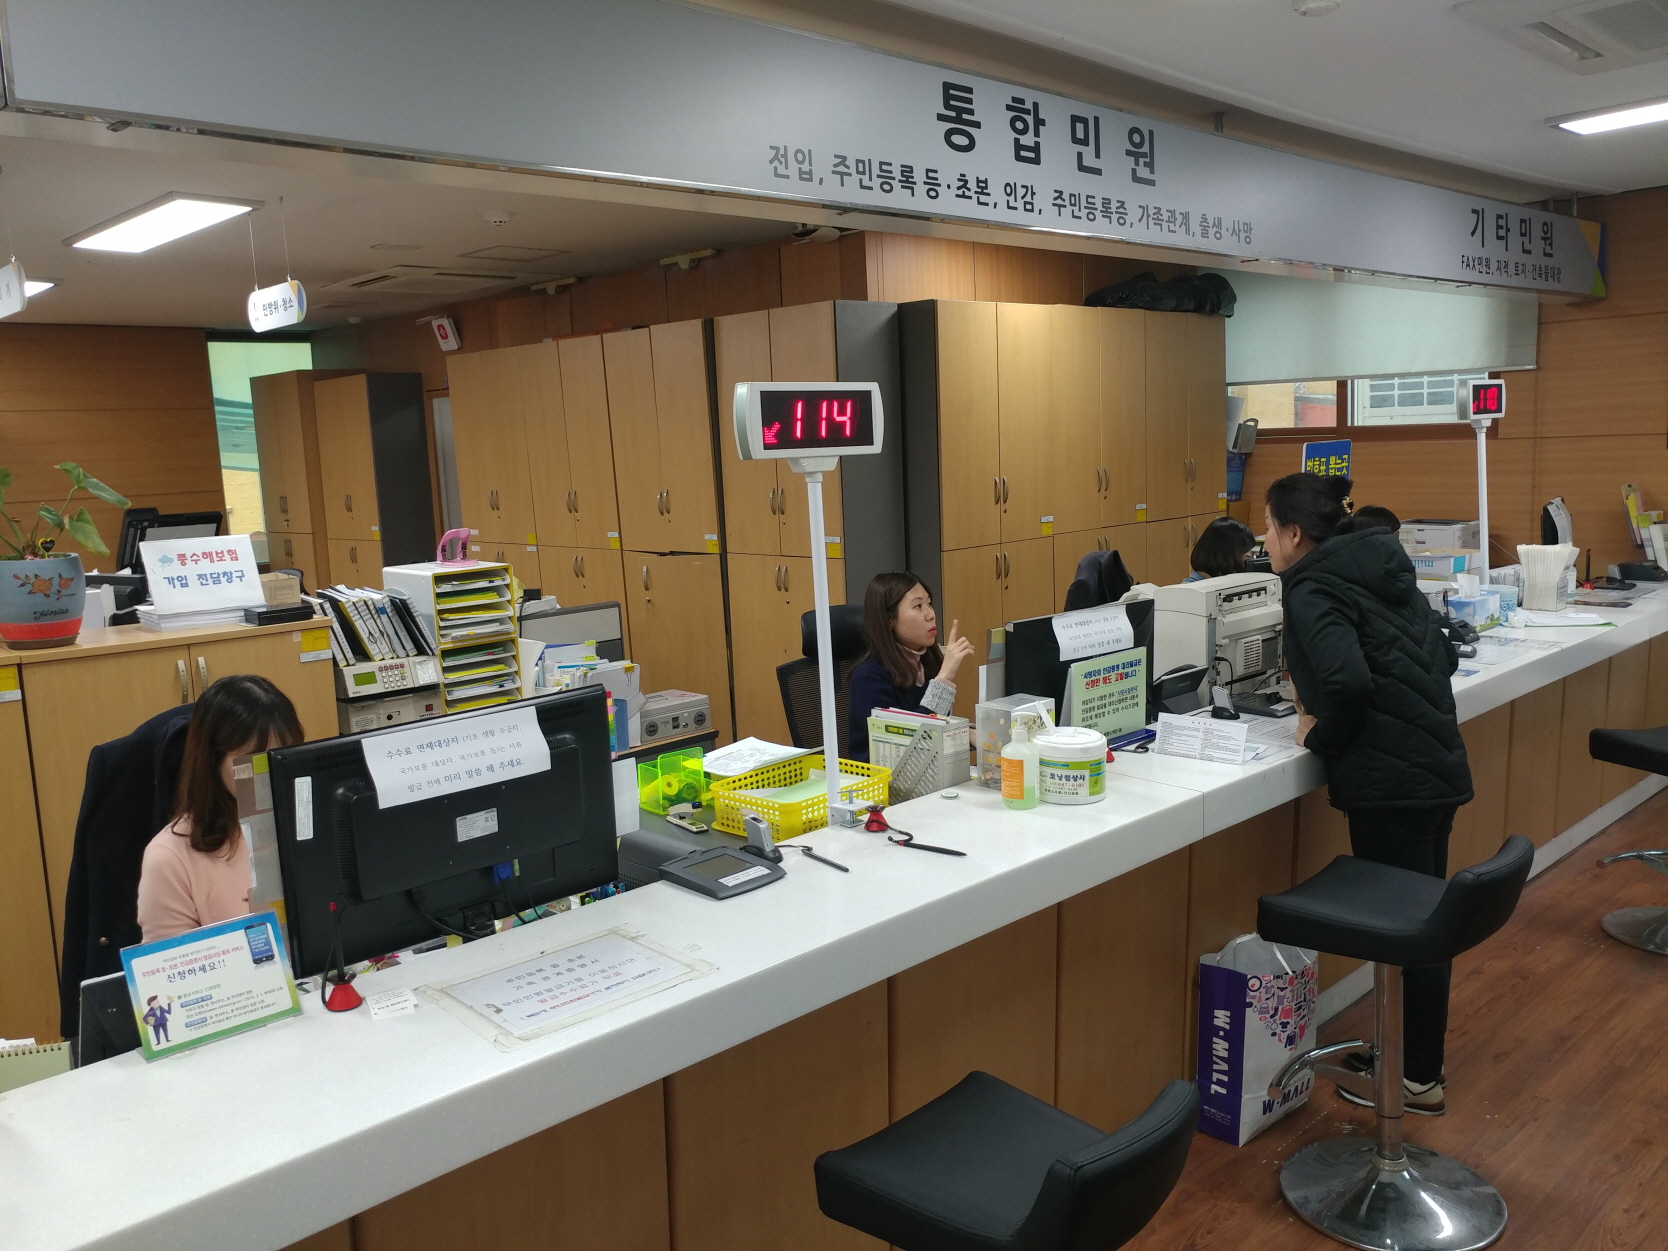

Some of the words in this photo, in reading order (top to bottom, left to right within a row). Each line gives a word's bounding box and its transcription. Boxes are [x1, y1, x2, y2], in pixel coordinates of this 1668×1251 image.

[1470, 208, 1553, 258] 기타민원
[794, 399, 852, 440] 114
[176, 549, 239, 567] 풍수해보험
[162, 575, 190, 589] 가입
[196, 570, 246, 586] 전담창구
[1084, 677, 1100, 689] 신청만
[1102, 674, 1112, 684] 해도
[386, 746, 412, 759] 수수료
[416, 736, 458, 752] 면제대상자
[482, 728, 495, 738] 생활
[399, 763, 428, 774] 국가보훈
[458, 749, 486, 760] 국가보훈
[509, 741, 522, 749] 서류
[407, 782, 422, 792] 발급
[426, 777, 441, 788] 전에
[444, 771, 461, 782] 미리
[465, 767, 482, 778] 말씀
[486, 763, 494, 772] 해
[167, 959, 225, 982] 신청하세요!!
